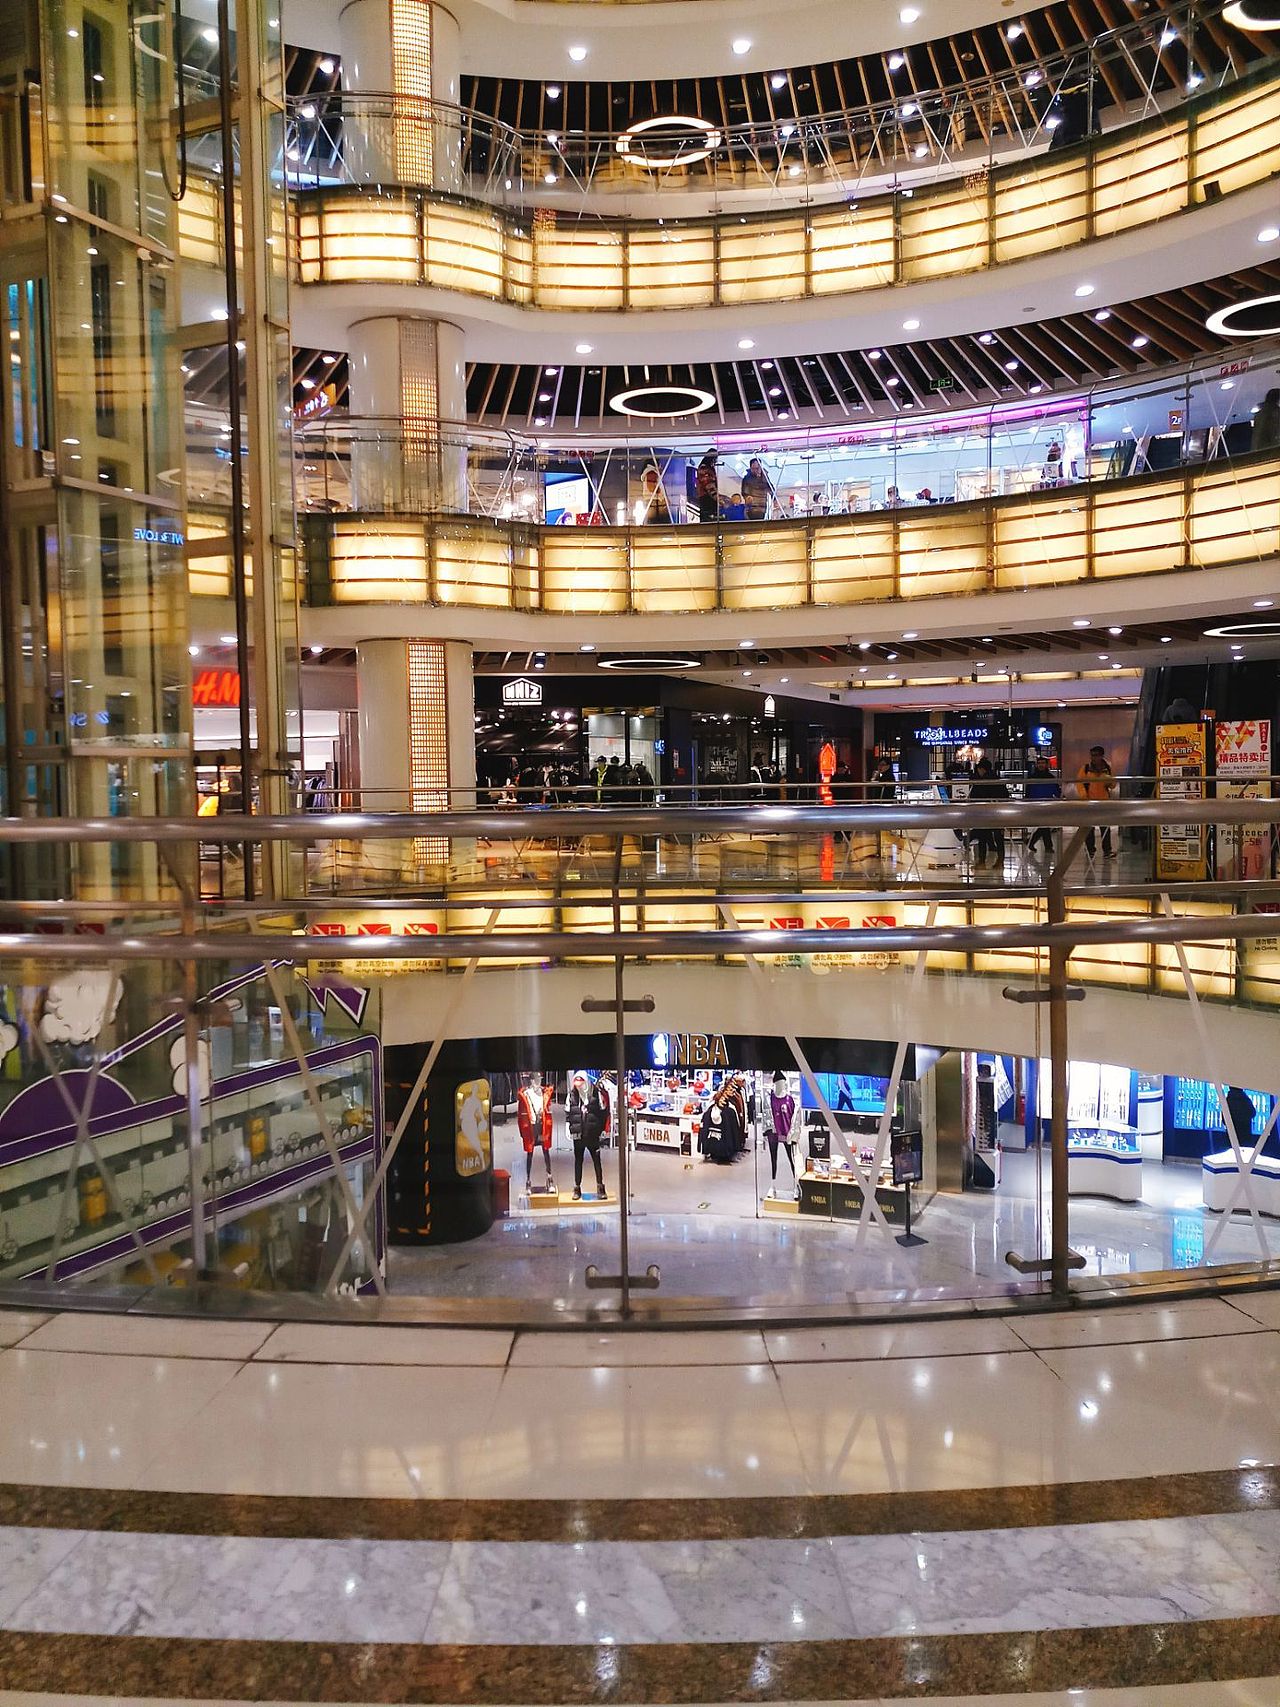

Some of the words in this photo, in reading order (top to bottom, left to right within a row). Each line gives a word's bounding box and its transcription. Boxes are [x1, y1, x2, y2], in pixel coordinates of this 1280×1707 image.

[1171, 415, 1182, 425] 2F
[192, 671, 240, 706] H&M
[1219, 752, 1270, 764] 精品特卖汇
[670, 1034, 730, 1066] NBA
[649, 1128, 671, 1143] NBA
[462, 1156, 481, 1169] NBA
